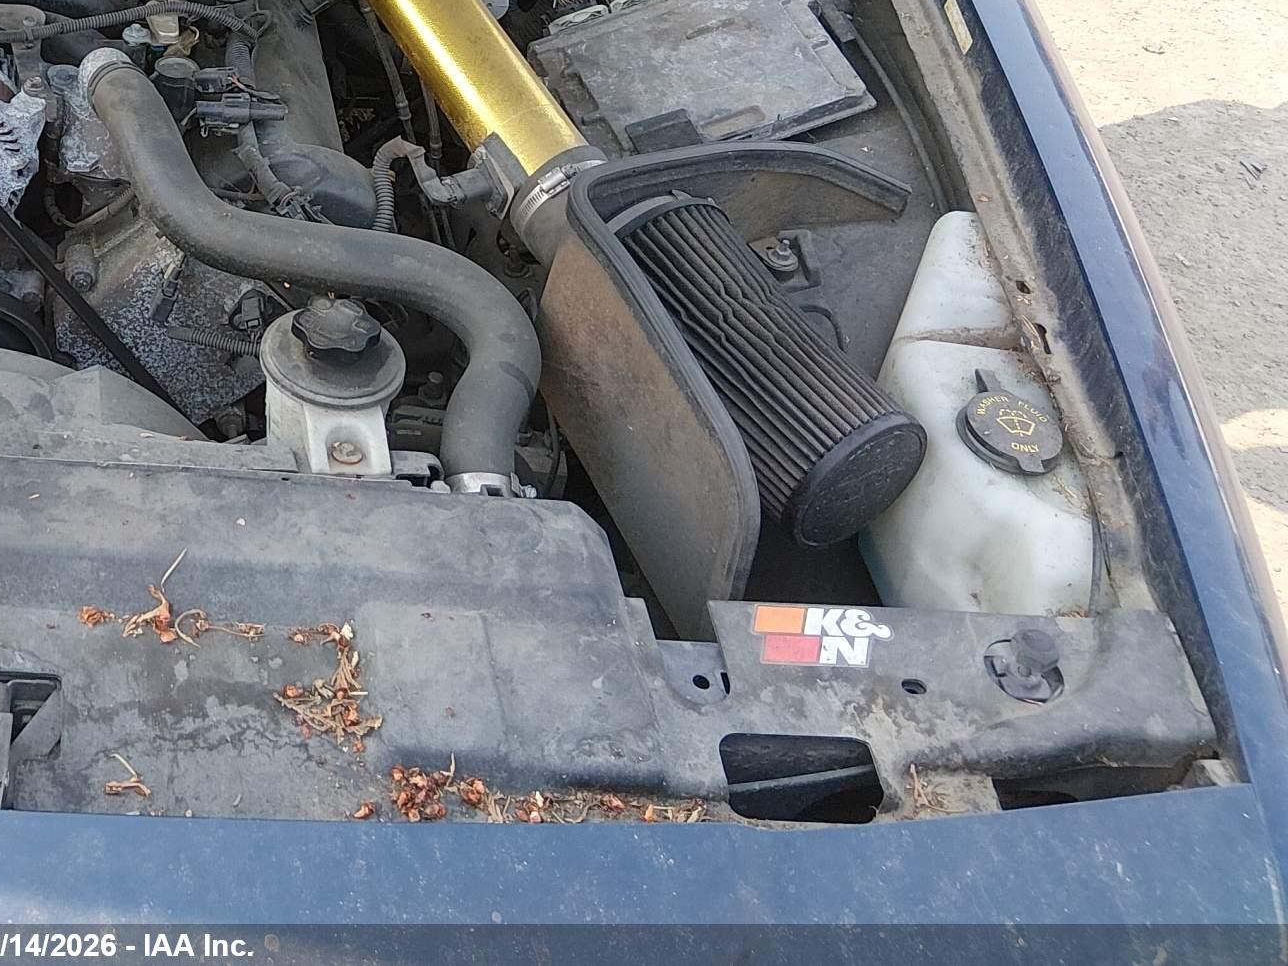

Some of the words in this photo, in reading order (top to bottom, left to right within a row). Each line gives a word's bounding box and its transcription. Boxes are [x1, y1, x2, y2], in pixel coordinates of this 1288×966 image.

[976, 395, 1009, 415] WASHER
[1018, 400, 1048, 423] FLUID
[1011, 442, 1040, 453] ONLY
